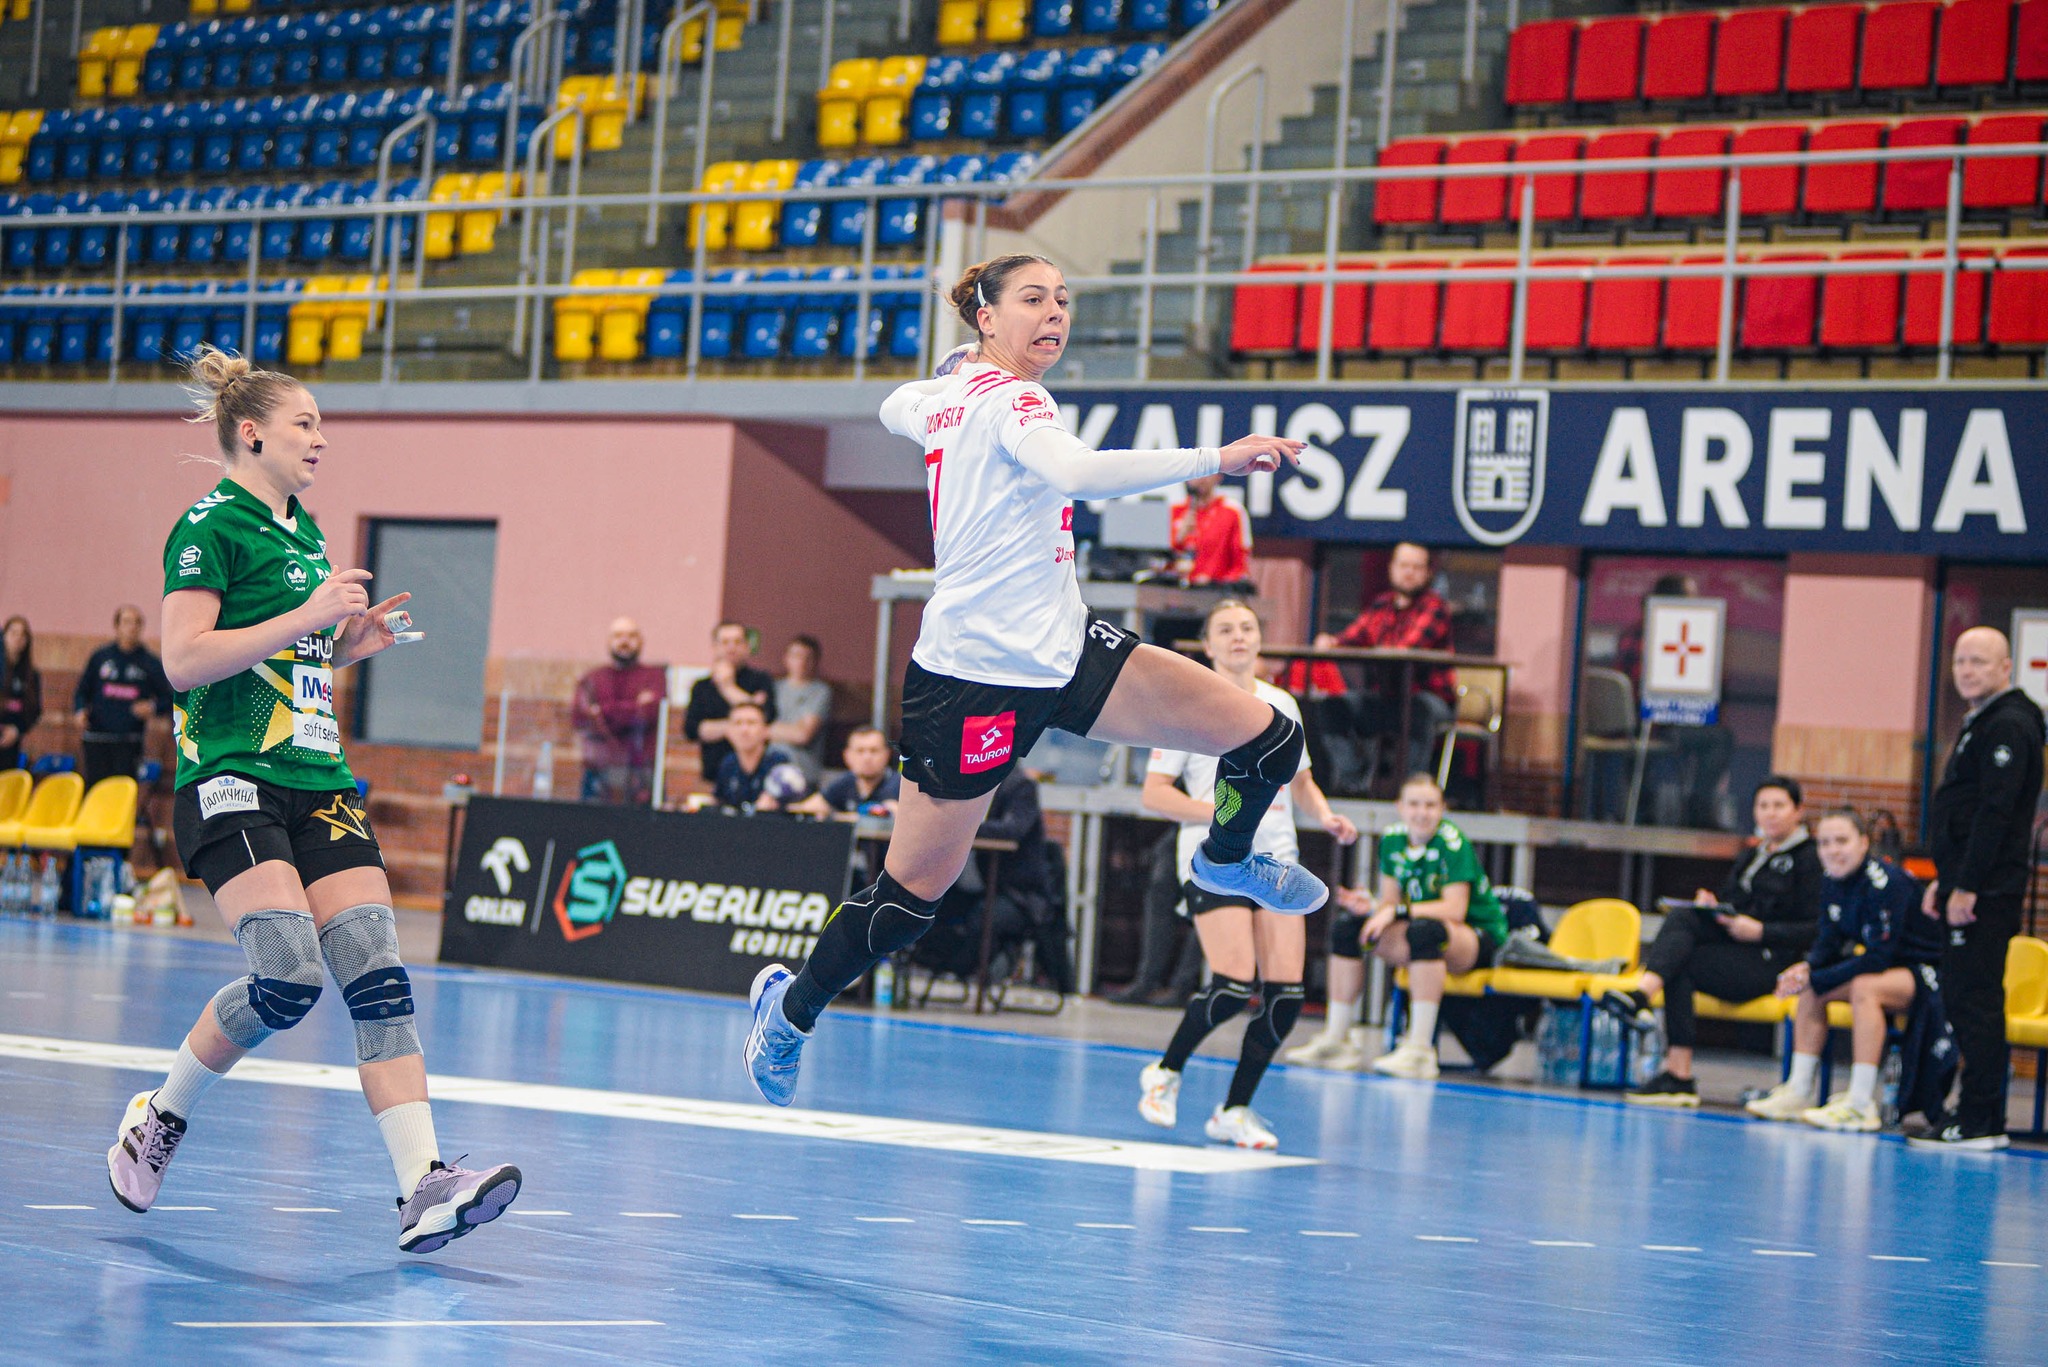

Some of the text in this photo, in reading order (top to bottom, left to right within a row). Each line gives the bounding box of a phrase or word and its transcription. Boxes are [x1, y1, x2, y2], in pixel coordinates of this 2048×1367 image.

[1060, 403, 2028, 533] KALISZ ARENA
[965, 745, 1010, 764] TAURON
[202, 788, 254, 810] ГАЛИЧИНА
[464, 895, 526, 927] ORLEN
[620, 876, 830, 933] SUPERLIGA
